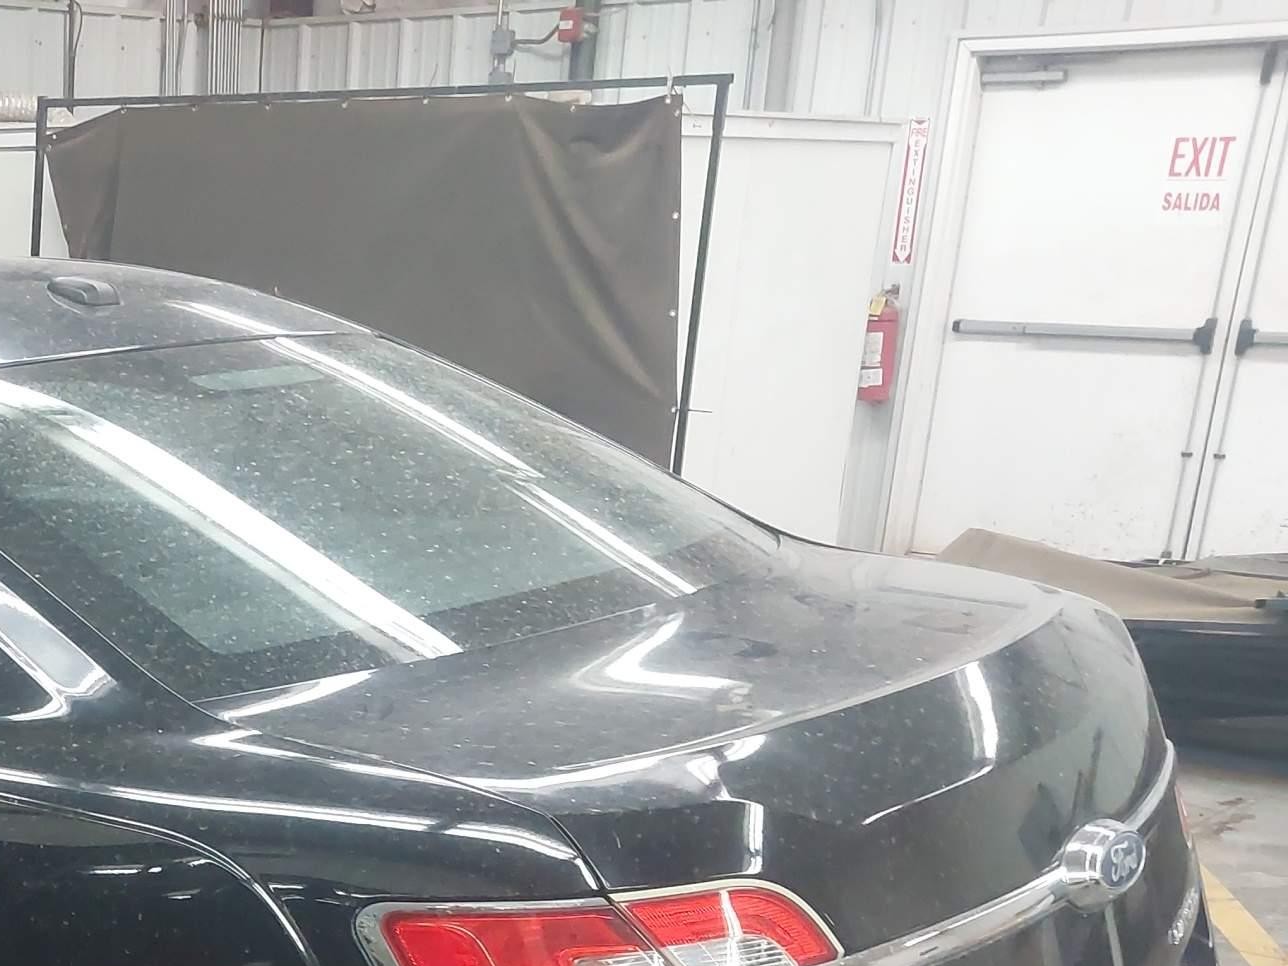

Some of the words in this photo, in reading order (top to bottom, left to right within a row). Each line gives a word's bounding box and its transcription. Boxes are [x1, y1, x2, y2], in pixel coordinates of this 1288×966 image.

[1168, 136, 1237, 177] EXIT
[899, 139, 921, 253] EXTINGUISHER
[1162, 192, 1220, 211] SALIDA
